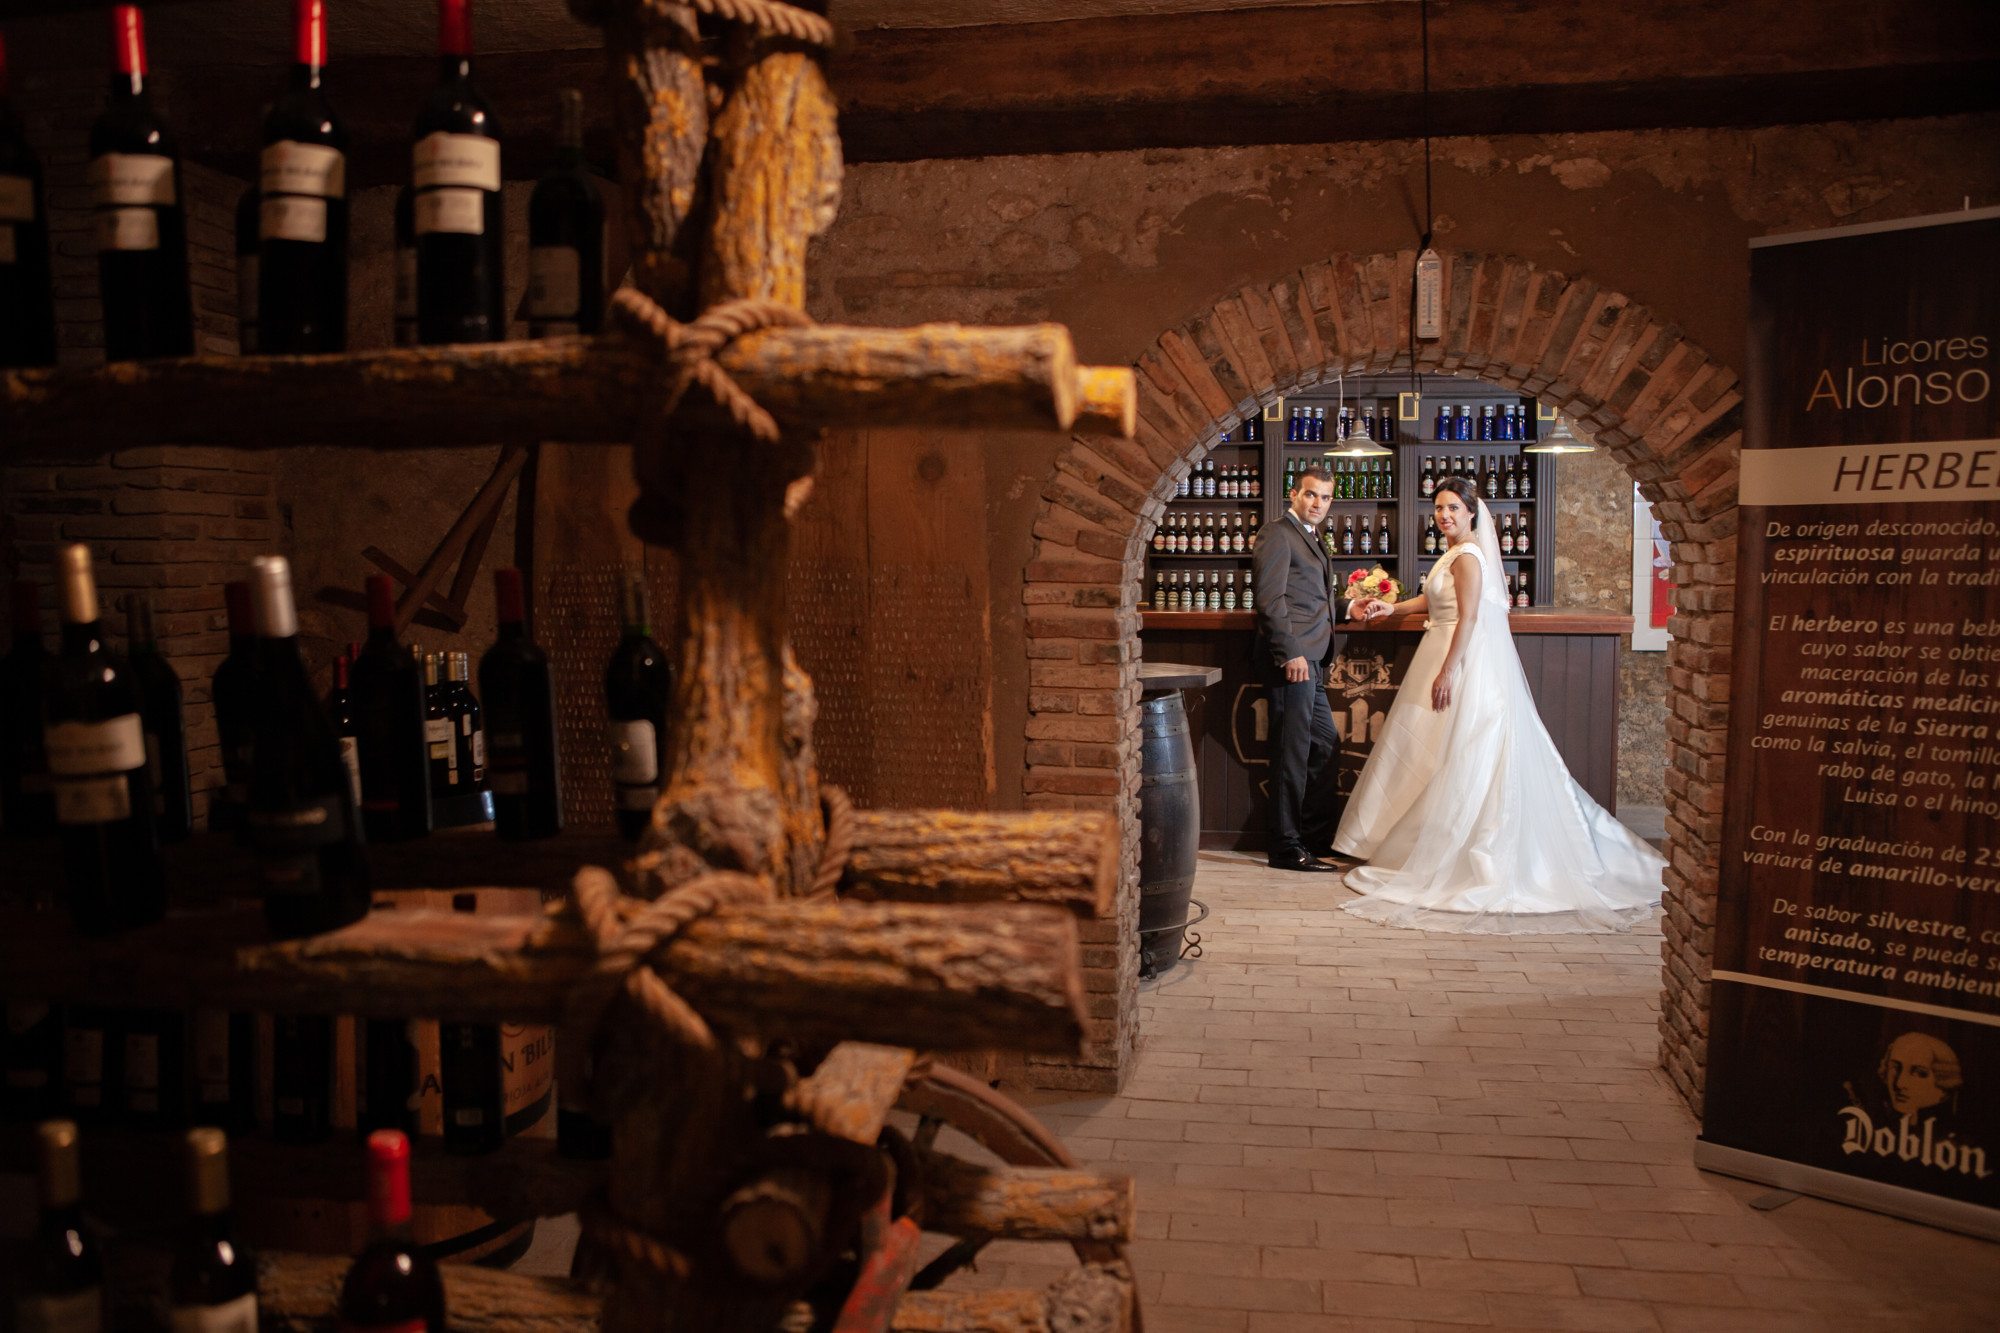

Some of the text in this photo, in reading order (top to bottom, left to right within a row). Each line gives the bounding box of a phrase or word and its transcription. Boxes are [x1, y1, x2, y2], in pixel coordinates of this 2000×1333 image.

[1862, 336, 1989, 366] Licores
[1806, 367, 1991, 411] Alonso
[1833, 451, 2000, 491] HERBE
[1766, 518, 2000, 540] De origen desconocido,
[1774, 545, 1895, 564] espirituosa
[1901, 544, 1980, 564] guarda
[1761, 568, 1870, 585] vinculación
[1876, 571, 1912, 585] con
[1919, 568, 1939, 585] la
[1769, 615, 1786, 631] El
[1791, 615, 1878, 633] herbero
[1884, 622, 1906, 634] es
[1913, 623, 1954, 636] una
[1801, 642, 1847, 660] cuyo
[1853, 641, 1912, 659] sabor
[1918, 646, 1941, 660] se
[1801, 666, 1918, 684] maceración
[1925, 668, 1950, 685] de
[1957, 669, 1989, 688] las
[1781, 689, 1904, 709] aromáticas
[1762, 713, 1850, 731] genuinas
[1857, 715, 1880, 732] de
[1888, 716, 1907, 733] la
[1914, 718, 1988, 739] Sierra
[1751, 735, 1801, 751] como
[1807, 735, 1825, 752] la
[1831, 738, 1897, 760] salvia,
[1905, 743, 1924, 759] el
[1817, 761, 1865, 779] rabo
[1871, 764, 1895, 782] de
[1902, 769, 1956, 789] gato,
[1965, 771, 1985, 789] la
[1844, 786, 1898, 806] Luisa
[1904, 795, 1917, 808] o
[1924, 793, 1943, 810] el
[1750, 825, 1786, 843] Con
[1792, 829, 1810, 845] la
[1816, 835, 1934, 860] graduación
[1941, 845, 1967, 863] de
[1743, 851, 1814, 870] variará
[1819, 856, 1843, 874] de
[1772, 898, 1798, 916] De
[1803, 904, 1862, 924] sabor
[1867, 911, 1971, 942] silvestre,
[1784, 926, 1876, 954] anisado,
[1884, 941, 1907, 957] se
[1912, 946, 1979, 968] puede
[1759, 946, 1897, 981] temperatura
[1837, 1106, 1993, 1179] Doblón
